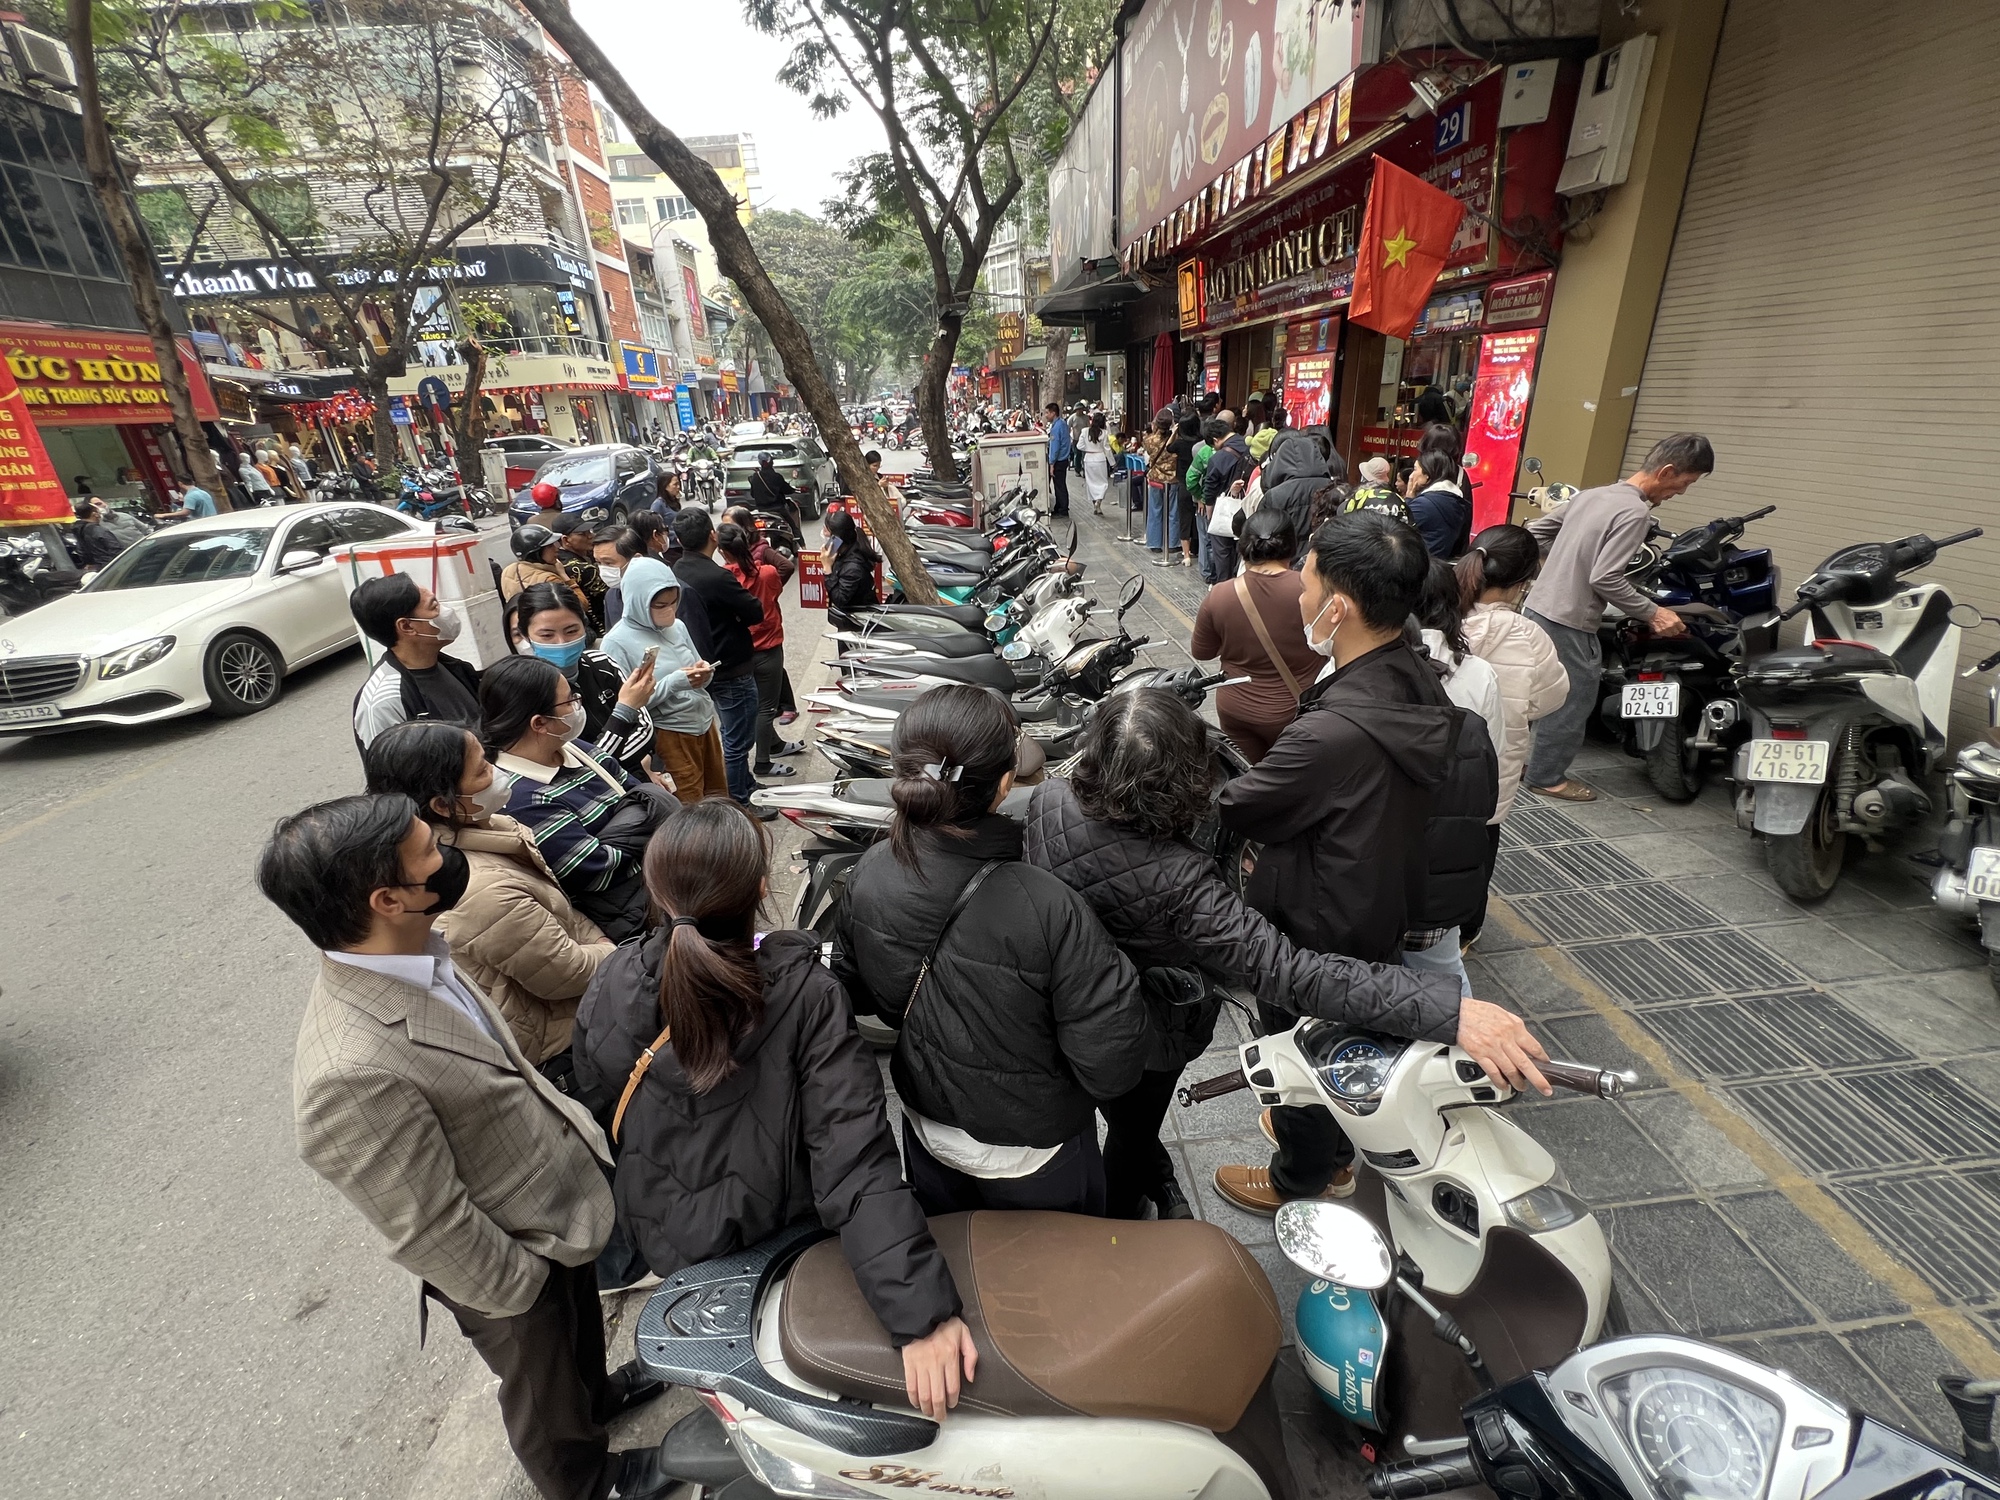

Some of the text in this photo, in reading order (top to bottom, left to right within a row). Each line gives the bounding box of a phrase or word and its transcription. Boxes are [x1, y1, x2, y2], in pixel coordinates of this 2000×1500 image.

[1438, 111, 1460, 147] 29
[1318, 204, 1359, 267] CH
[16, 338, 30, 346] TY
[4, 347, 161, 383] ỨC HÙN
[22, 386, 50, 405] NG
[131, 388, 160, 404] CAO
[554, 405, 566, 413] 20
[1630, 685, 1670, 701] 29-C2
[1625, 701, 1673, 716] 024.91
[1761, 743, 1815, 761] 29-G1
[1754, 761, 1820, 780] 416.22
[1329, 1283, 1351, 1311] Ca
[1342, 1359, 1361, 1415] Casper
